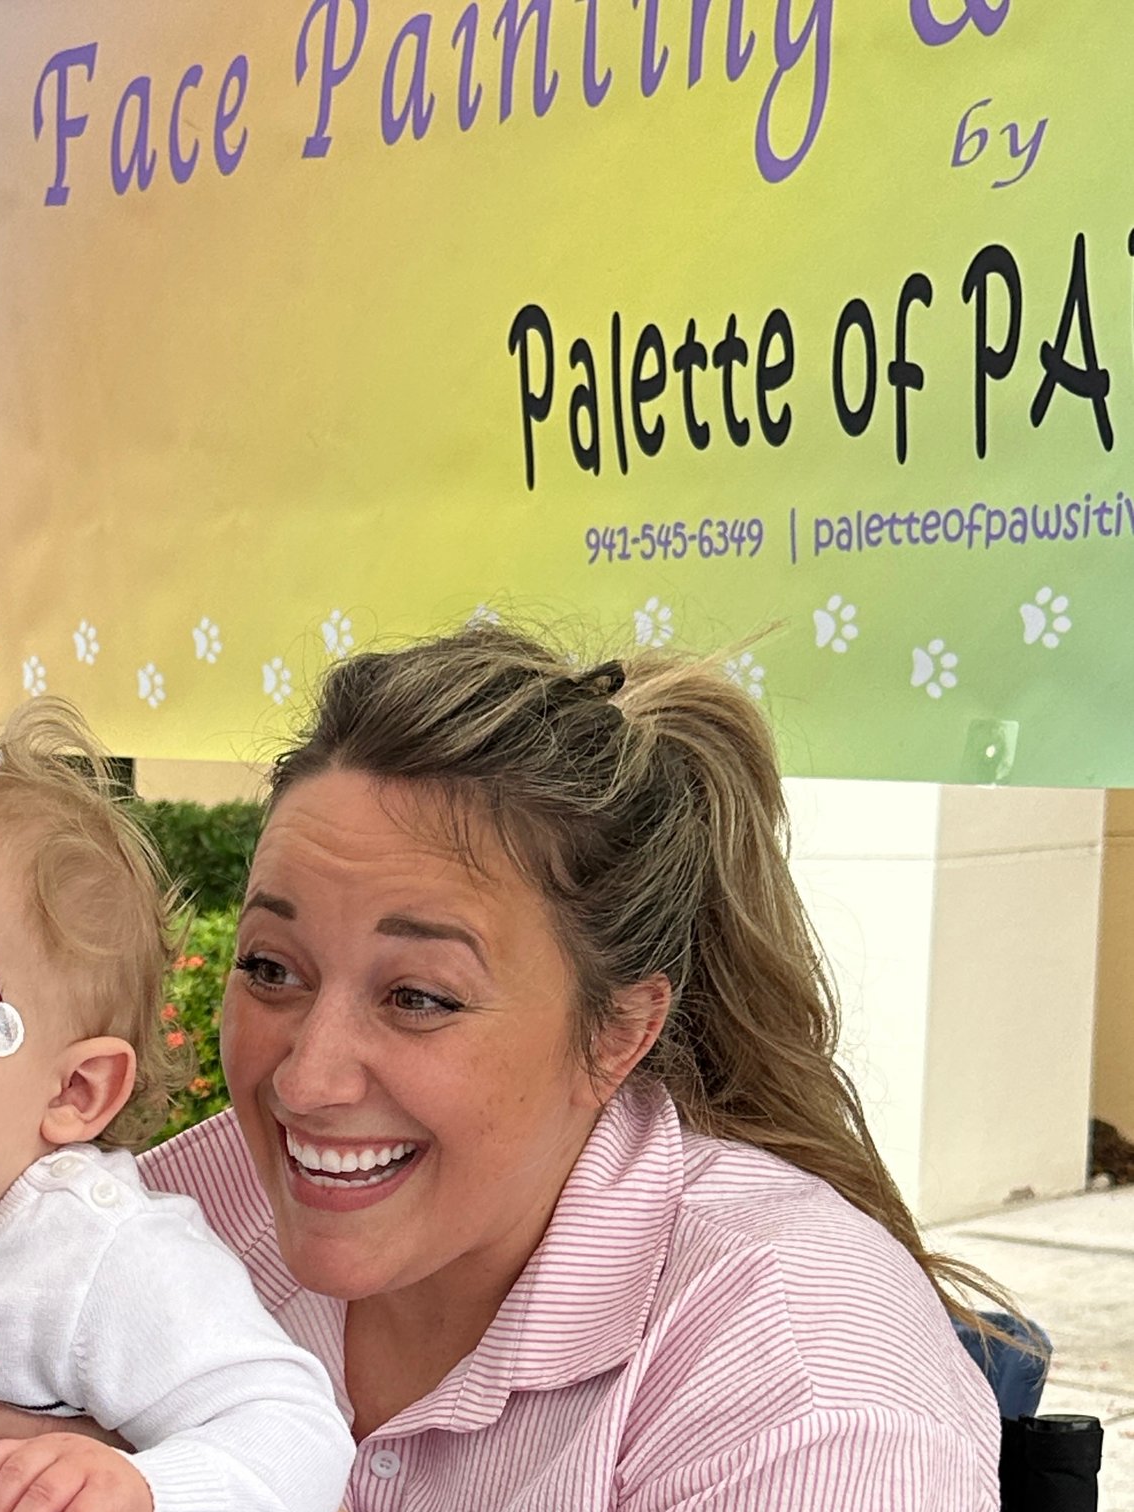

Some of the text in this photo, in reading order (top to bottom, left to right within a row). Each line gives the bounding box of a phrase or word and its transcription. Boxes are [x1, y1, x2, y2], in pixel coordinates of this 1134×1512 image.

[33, 0, 833, 206] Face Painting
[951, 98, 1049, 189] by
[509, 304, 795, 491] Palette
[961, 228, 1134, 460] PA
[585, 518, 764, 565] 941-545-6349
